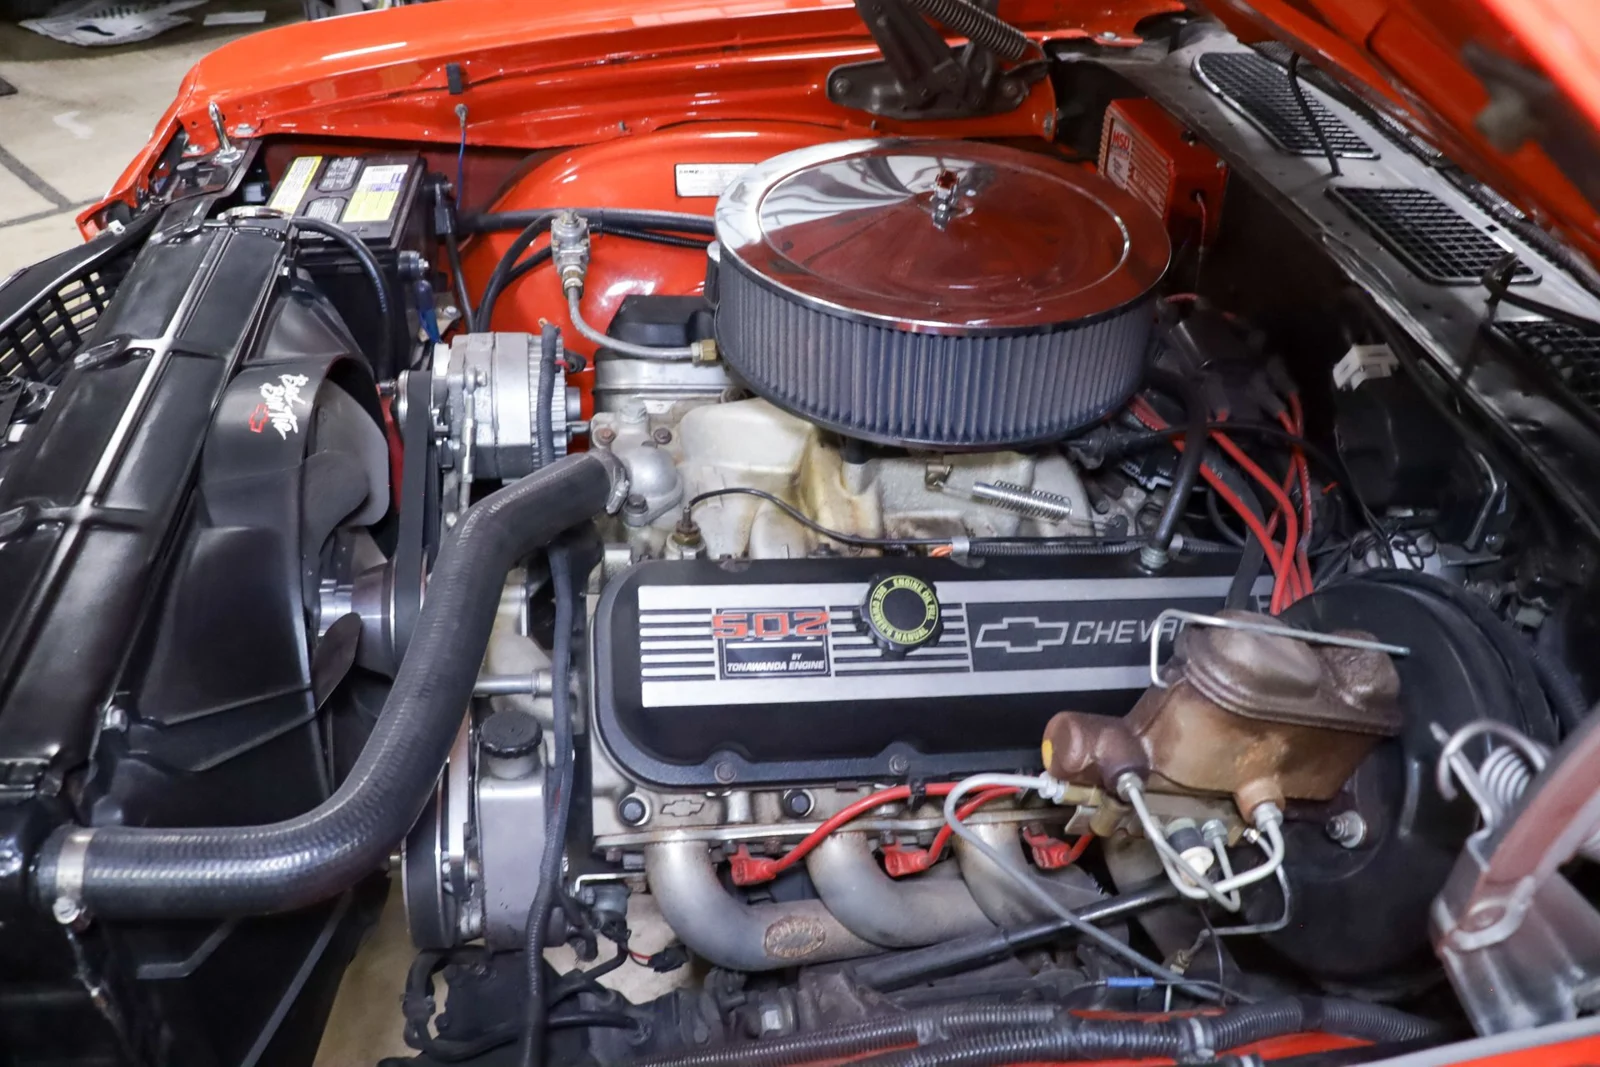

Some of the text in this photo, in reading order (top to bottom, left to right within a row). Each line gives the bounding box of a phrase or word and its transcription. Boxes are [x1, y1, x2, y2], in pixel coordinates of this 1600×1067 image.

[872, 585, 929, 641] SEE OWNER'S MANUAL
[893, 578, 936, 620] ENGINE OIL FILL
[711, 611, 829, 638] 502
[727, 660, 825, 672] TONAWANDA ENGINE
